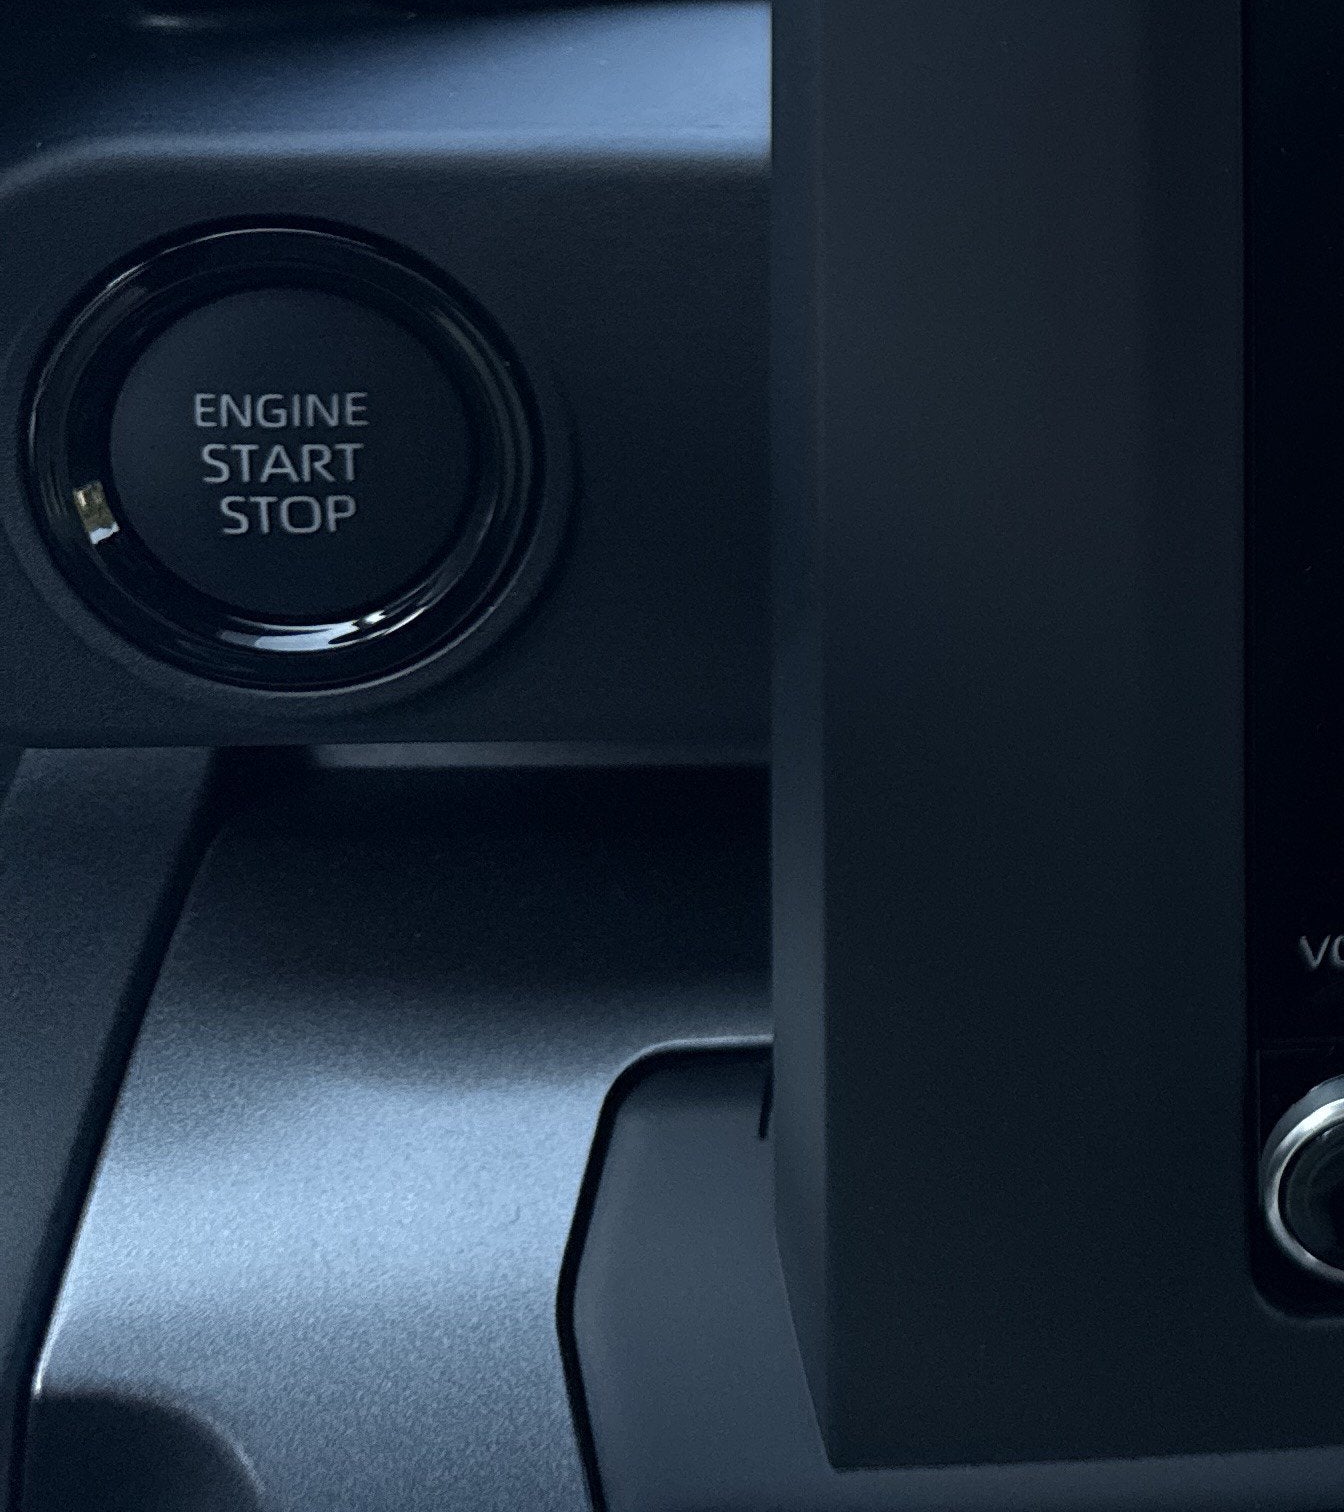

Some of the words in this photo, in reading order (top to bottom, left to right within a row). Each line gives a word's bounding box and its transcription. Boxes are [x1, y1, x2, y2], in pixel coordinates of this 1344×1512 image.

[193, 391, 369, 428] ENGINE
[202, 442, 363, 484] START
[219, 493, 356, 536] STOP
